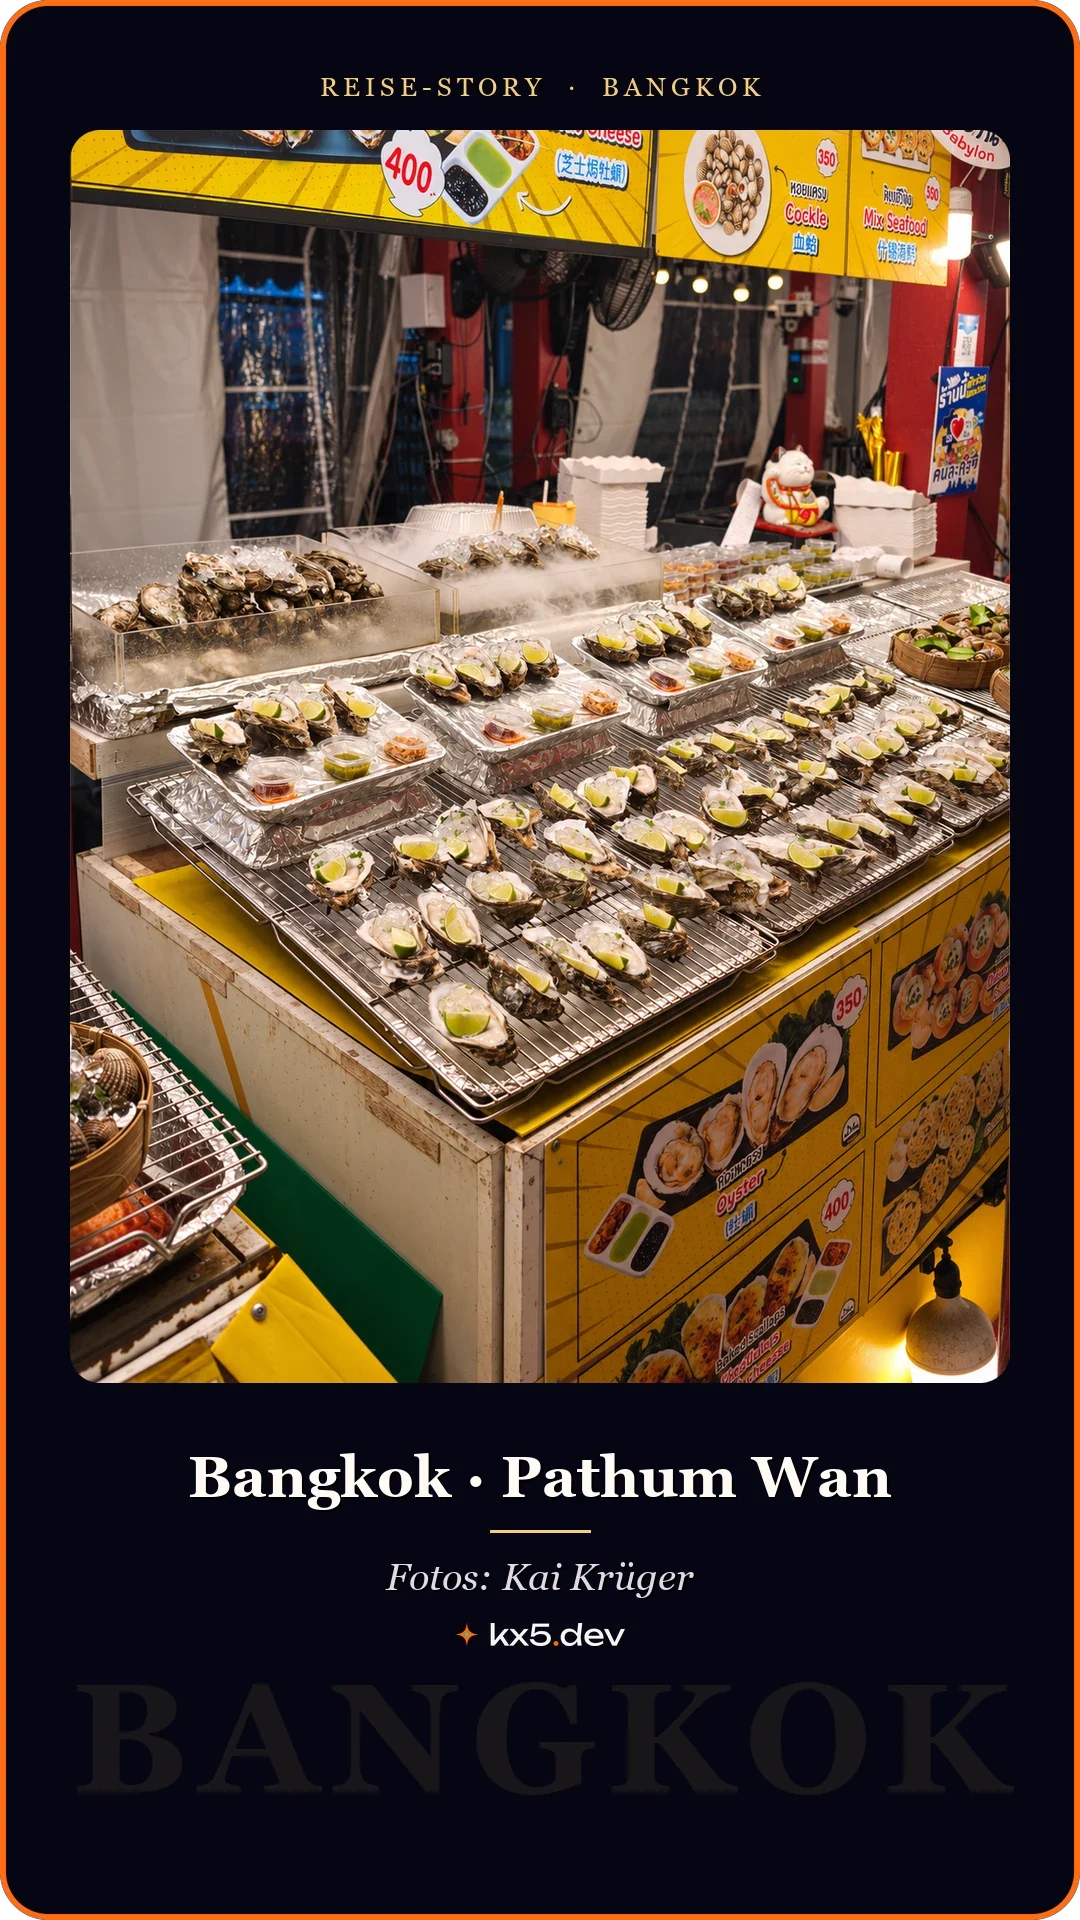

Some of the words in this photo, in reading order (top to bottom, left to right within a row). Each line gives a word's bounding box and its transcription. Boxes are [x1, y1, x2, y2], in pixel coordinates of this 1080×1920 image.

[384, 146, 432, 193] 400
[818, 148, 836, 167] 350
[785, 203, 828, 227] Cockle
[864, 208, 884, 228] Mix
[886, 212, 927, 236] Seafood
[836, 987, 861, 1020] 350
[716, 1169, 764, 1214] Oyster
[824, 1191, 849, 1221] 400
